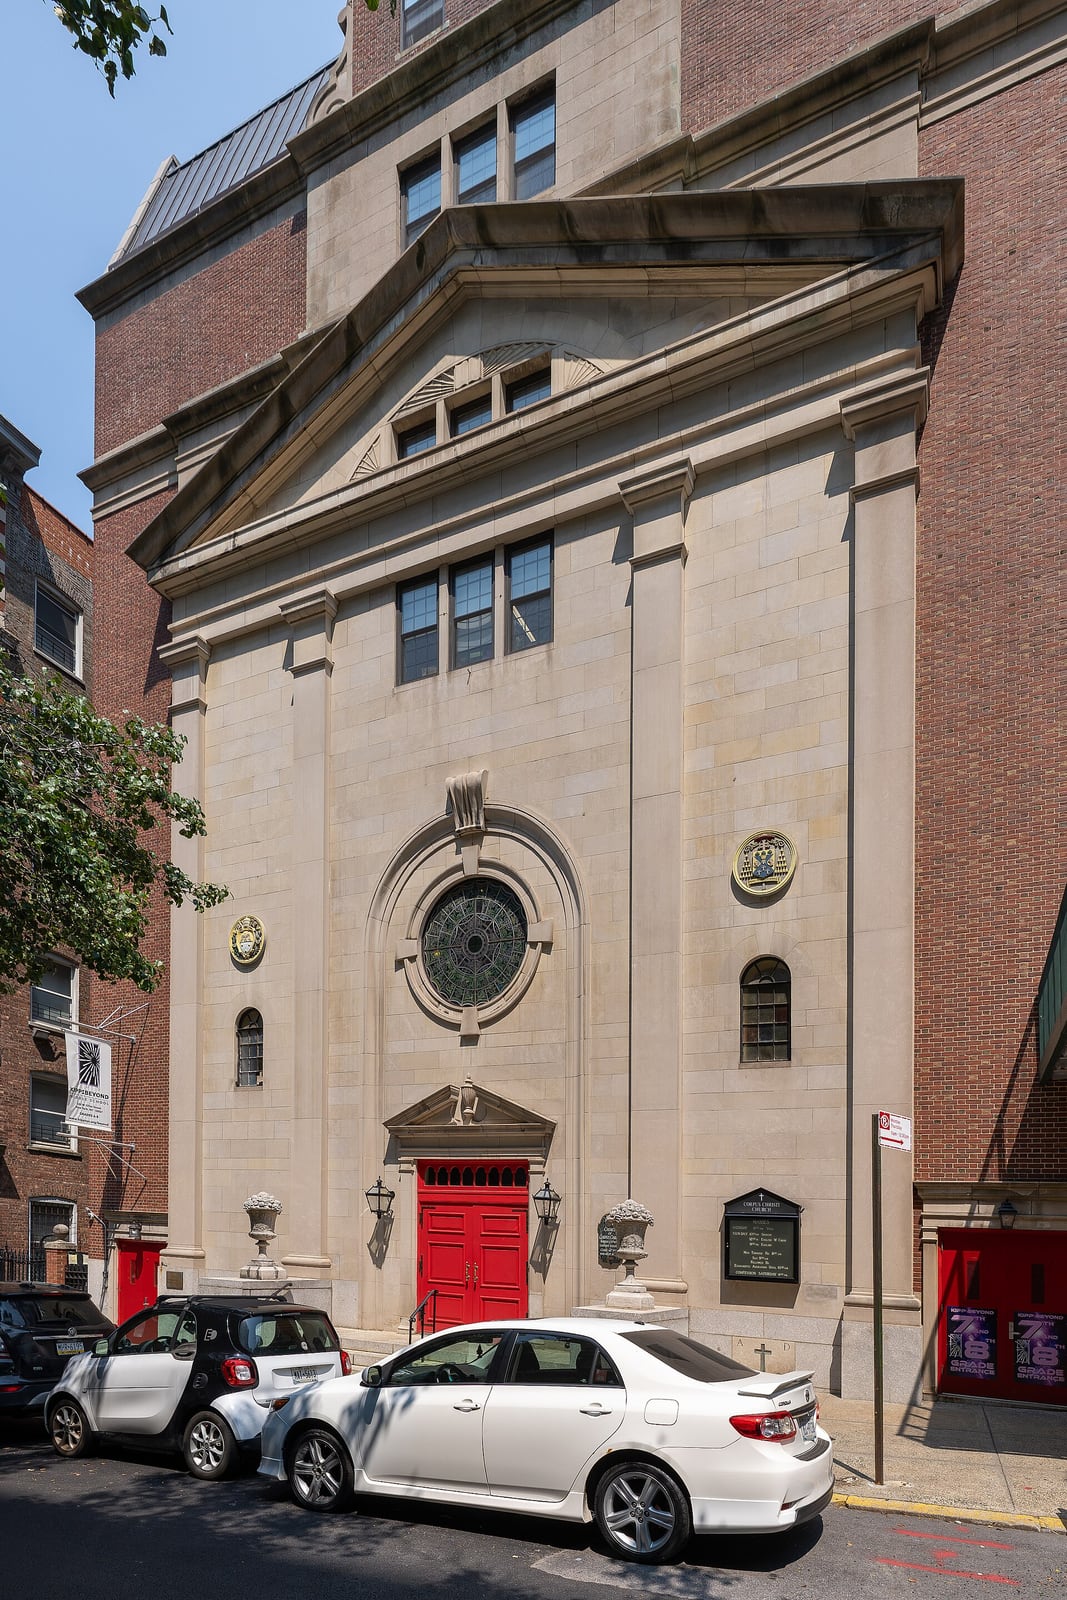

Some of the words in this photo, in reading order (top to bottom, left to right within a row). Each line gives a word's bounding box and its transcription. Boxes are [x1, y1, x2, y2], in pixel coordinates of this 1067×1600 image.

[736, 1338, 744, 1347] A
[783, 1342, 791, 1352] D
[950, 1359, 996, 1370] GRADE
[949, 1366, 996, 1376] ENTRANCE
[1017, 1366, 1065, 1377] GRADE
[1016, 1373, 1066, 1382] ENTRANCE
